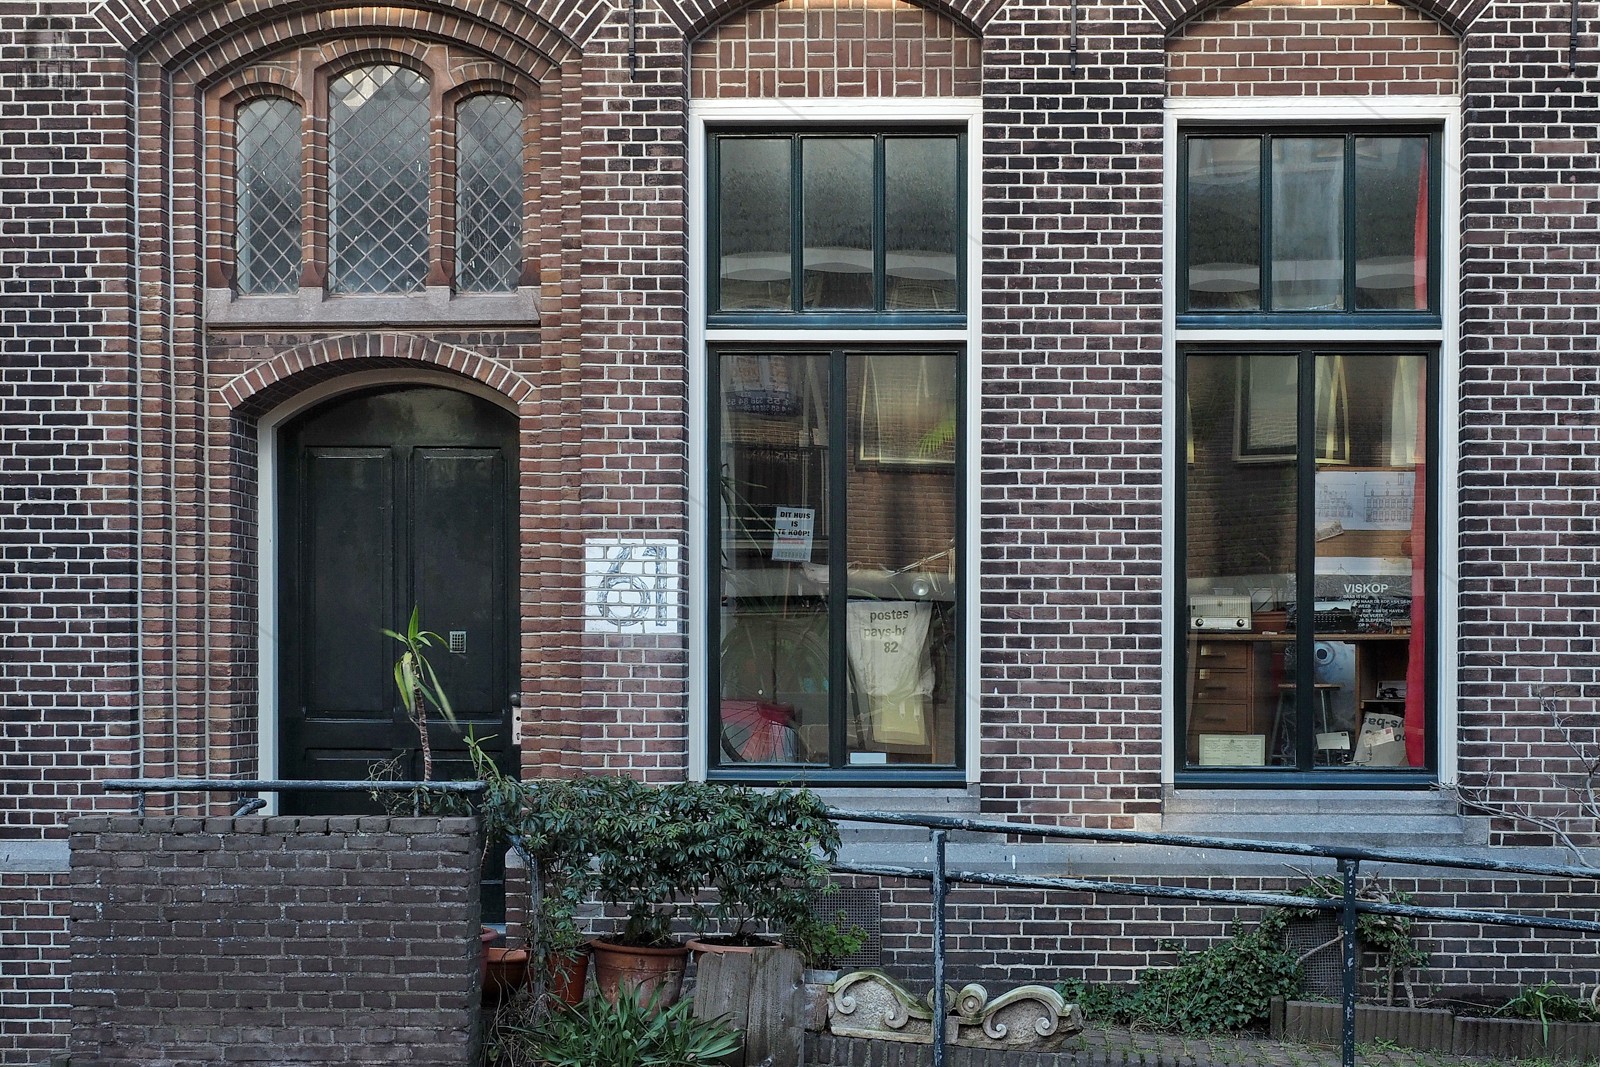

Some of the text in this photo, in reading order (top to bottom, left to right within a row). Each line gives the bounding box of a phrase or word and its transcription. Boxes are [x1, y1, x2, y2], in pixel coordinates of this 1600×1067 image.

[597, 543, 667, 626] 61
[1343, 583, 1389, 593] VISKOP
[870, 609, 909, 623] postes
[883, 641, 899, 653] 82
